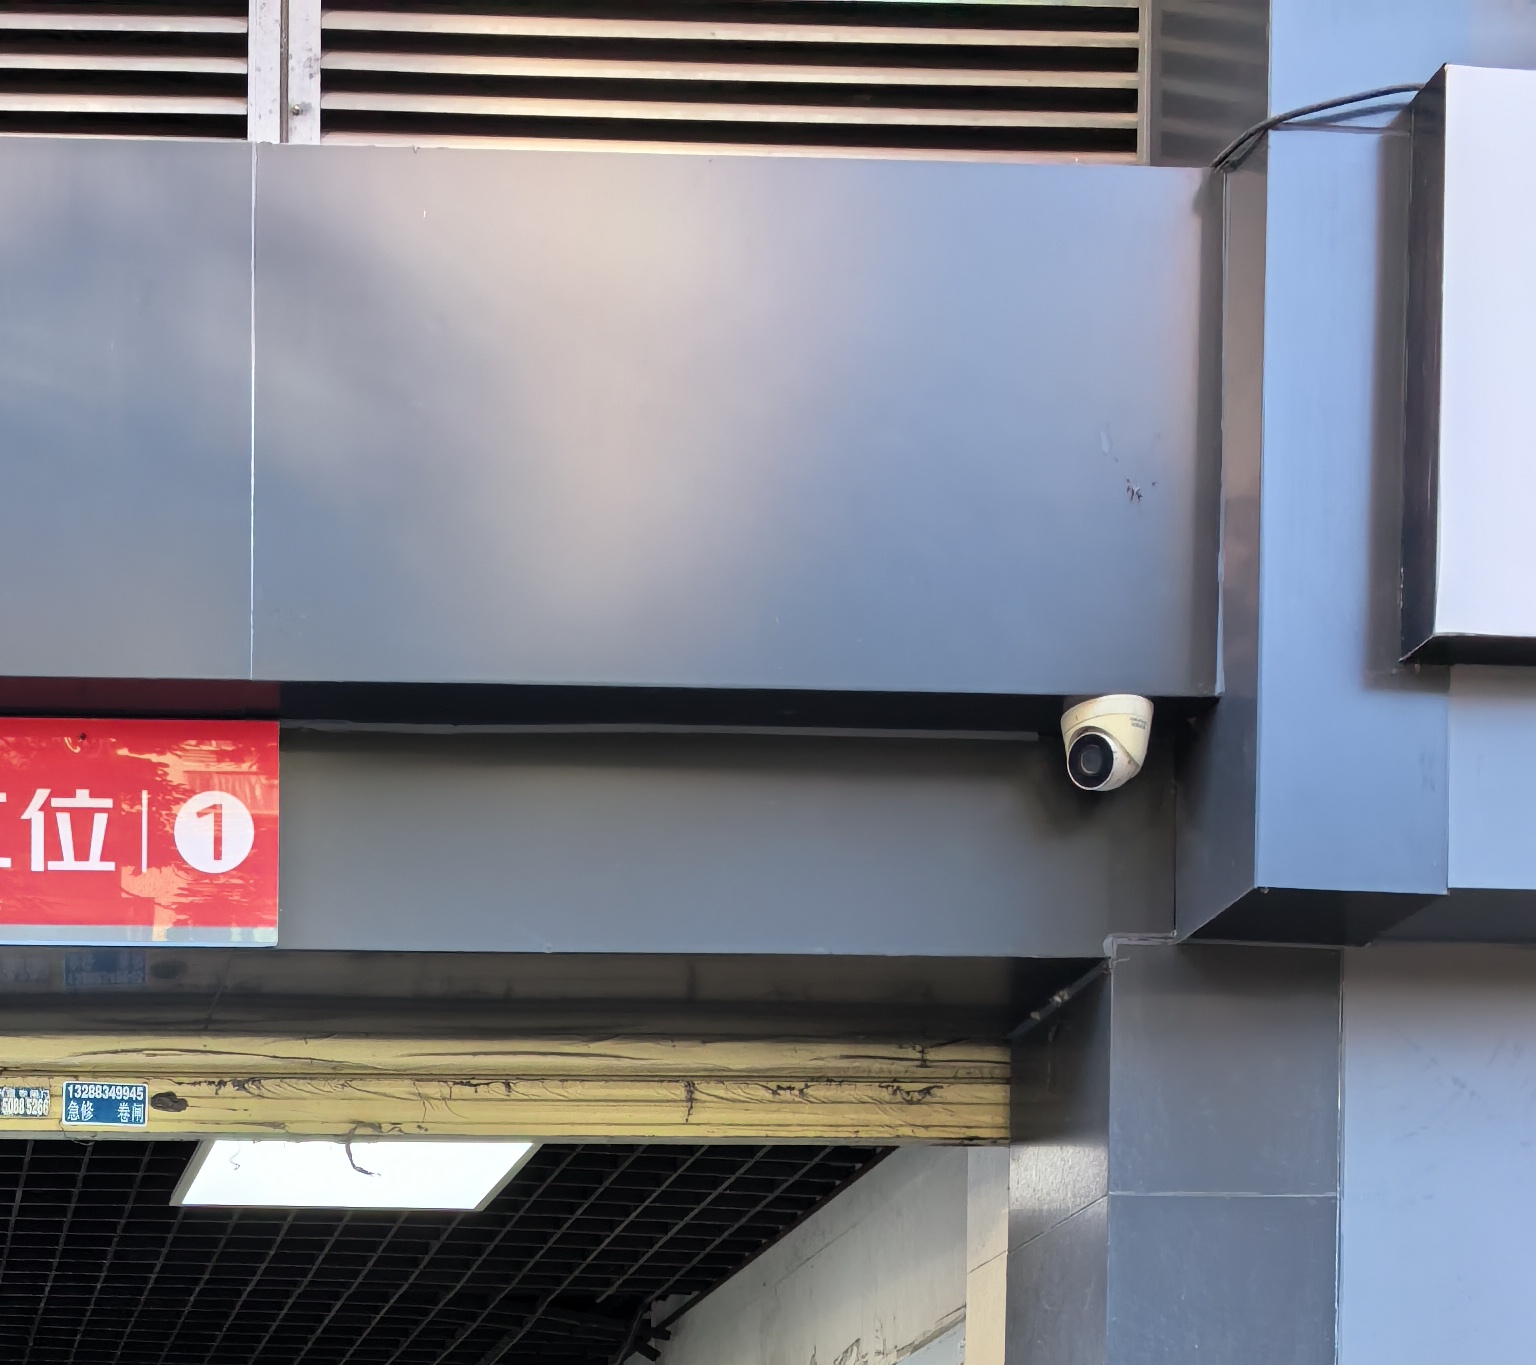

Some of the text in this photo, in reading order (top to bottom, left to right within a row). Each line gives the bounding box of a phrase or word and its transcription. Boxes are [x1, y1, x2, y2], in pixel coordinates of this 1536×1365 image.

[67, 1084, 144, 1101] 13288349945
[67, 1100, 144, 1123] 急修 卷闸
